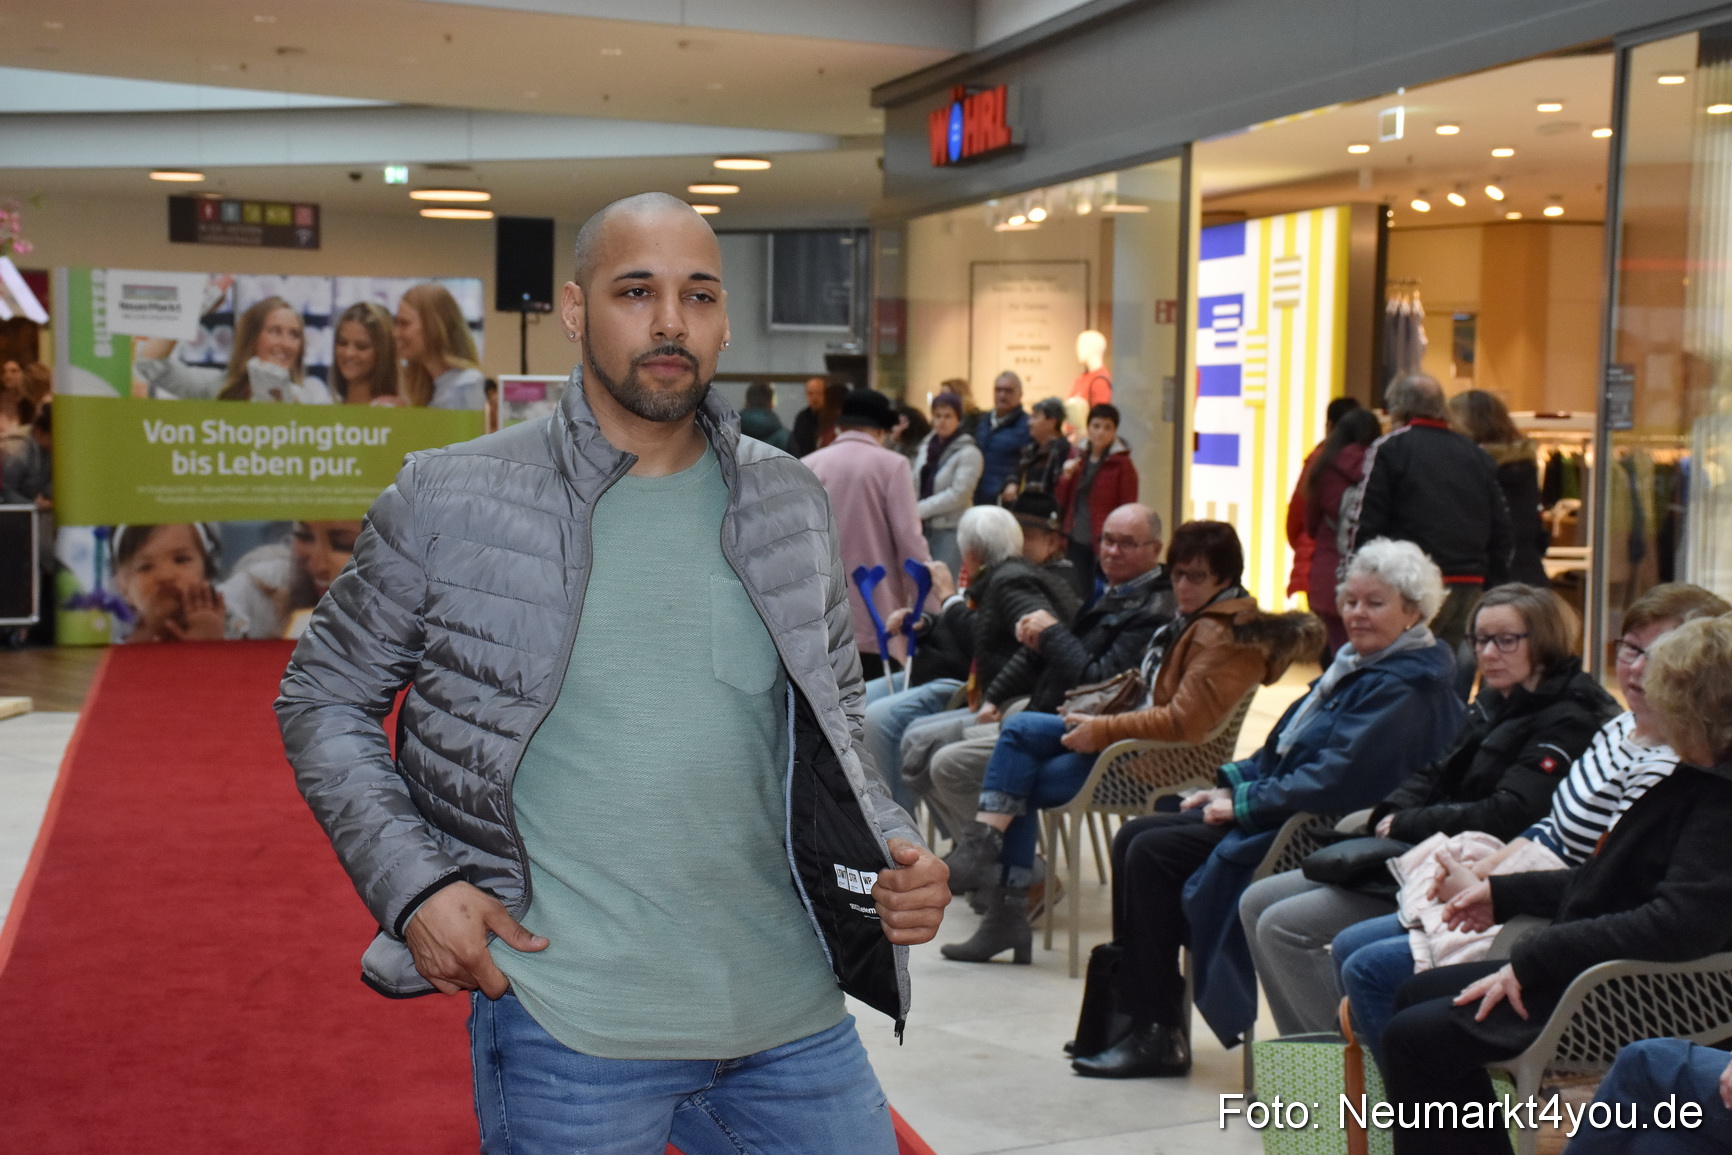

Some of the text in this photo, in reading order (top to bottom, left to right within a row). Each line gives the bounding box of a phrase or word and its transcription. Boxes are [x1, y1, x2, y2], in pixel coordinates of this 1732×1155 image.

[929, 85, 1011, 168] WÖHRL
[143, 419, 392, 450] Von Shoppingtour
[172, 450, 362, 480] bis Leben pur.
